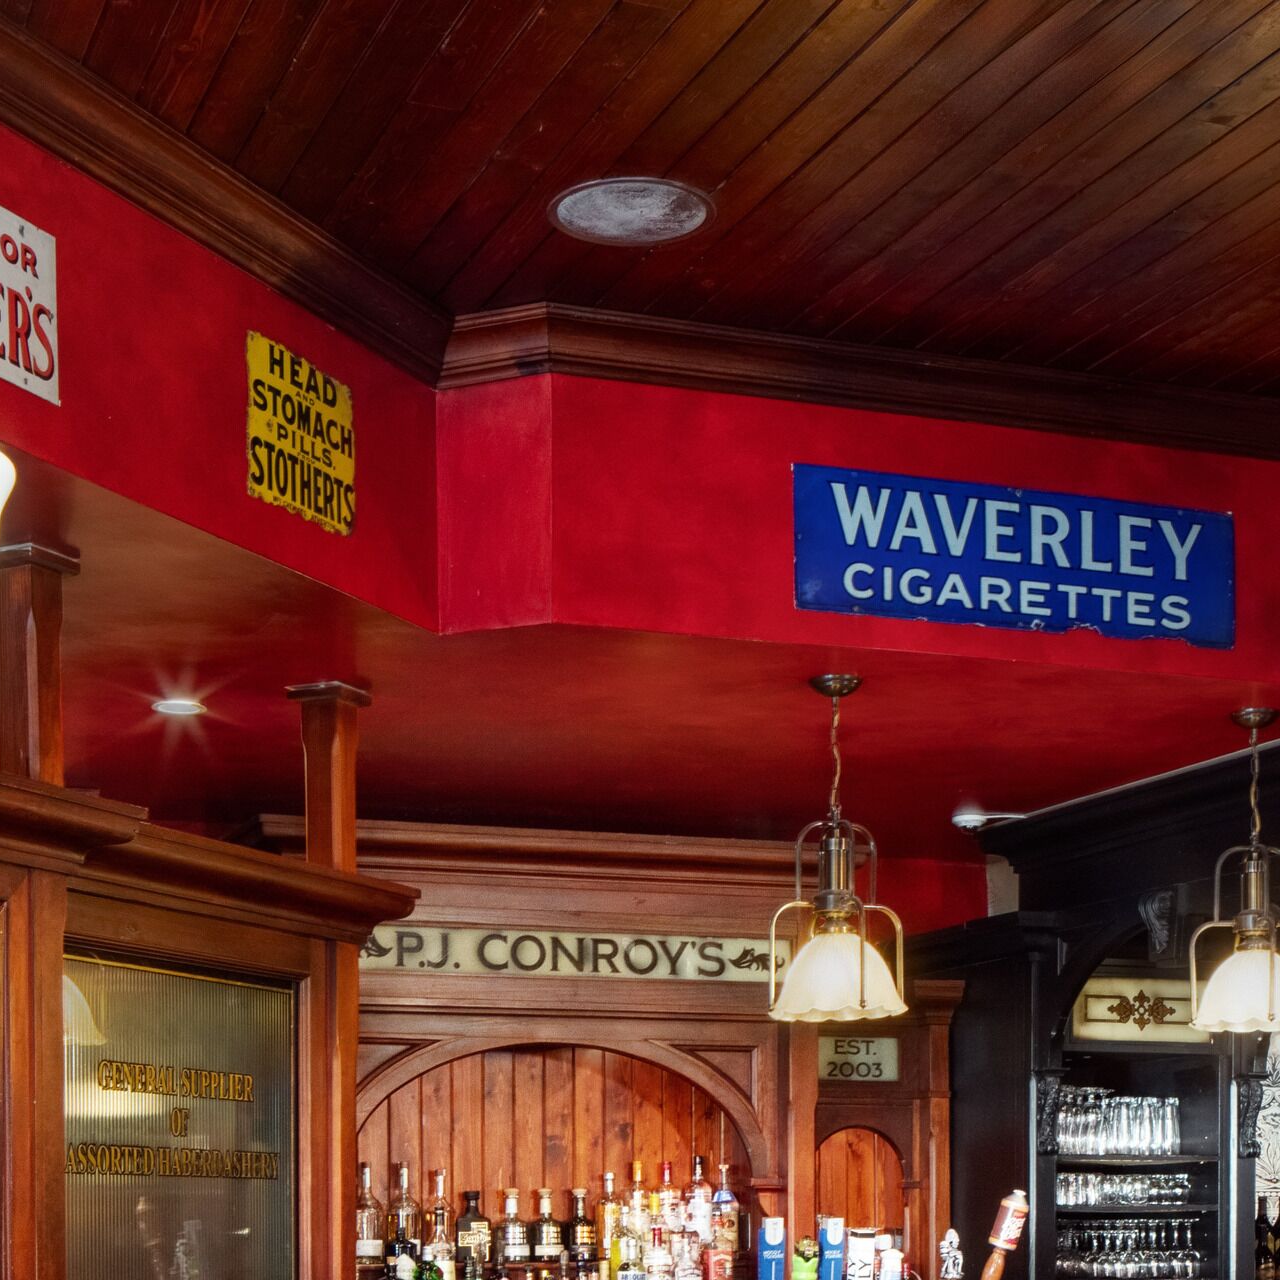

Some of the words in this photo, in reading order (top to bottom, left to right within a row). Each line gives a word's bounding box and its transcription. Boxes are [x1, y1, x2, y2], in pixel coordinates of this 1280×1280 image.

[268, 343, 338, 408] HEAD
[295, 390, 315, 406] AND
[252, 378, 353, 459] STOMACH
[250, 435, 355, 529] STOTHERTS
[830, 481, 1203, 581] WAVERLEY
[842, 562, 1192, 631] CIGARETTES
[394, 930, 461, 969] P.J.
[477, 932, 726, 978] CONROY'S
[827, 1060, 884, 1078] 2003
[833, 1038, 877, 1056] EST.
[97, 1058, 178, 1097] GENERAL
[179, 1066, 255, 1102] SUPPLIER
[169, 1106, 191, 1137] OF
[65, 1143, 156, 1176] ASSORTED
[157, 1144, 281, 1181] HABERDASHERY
